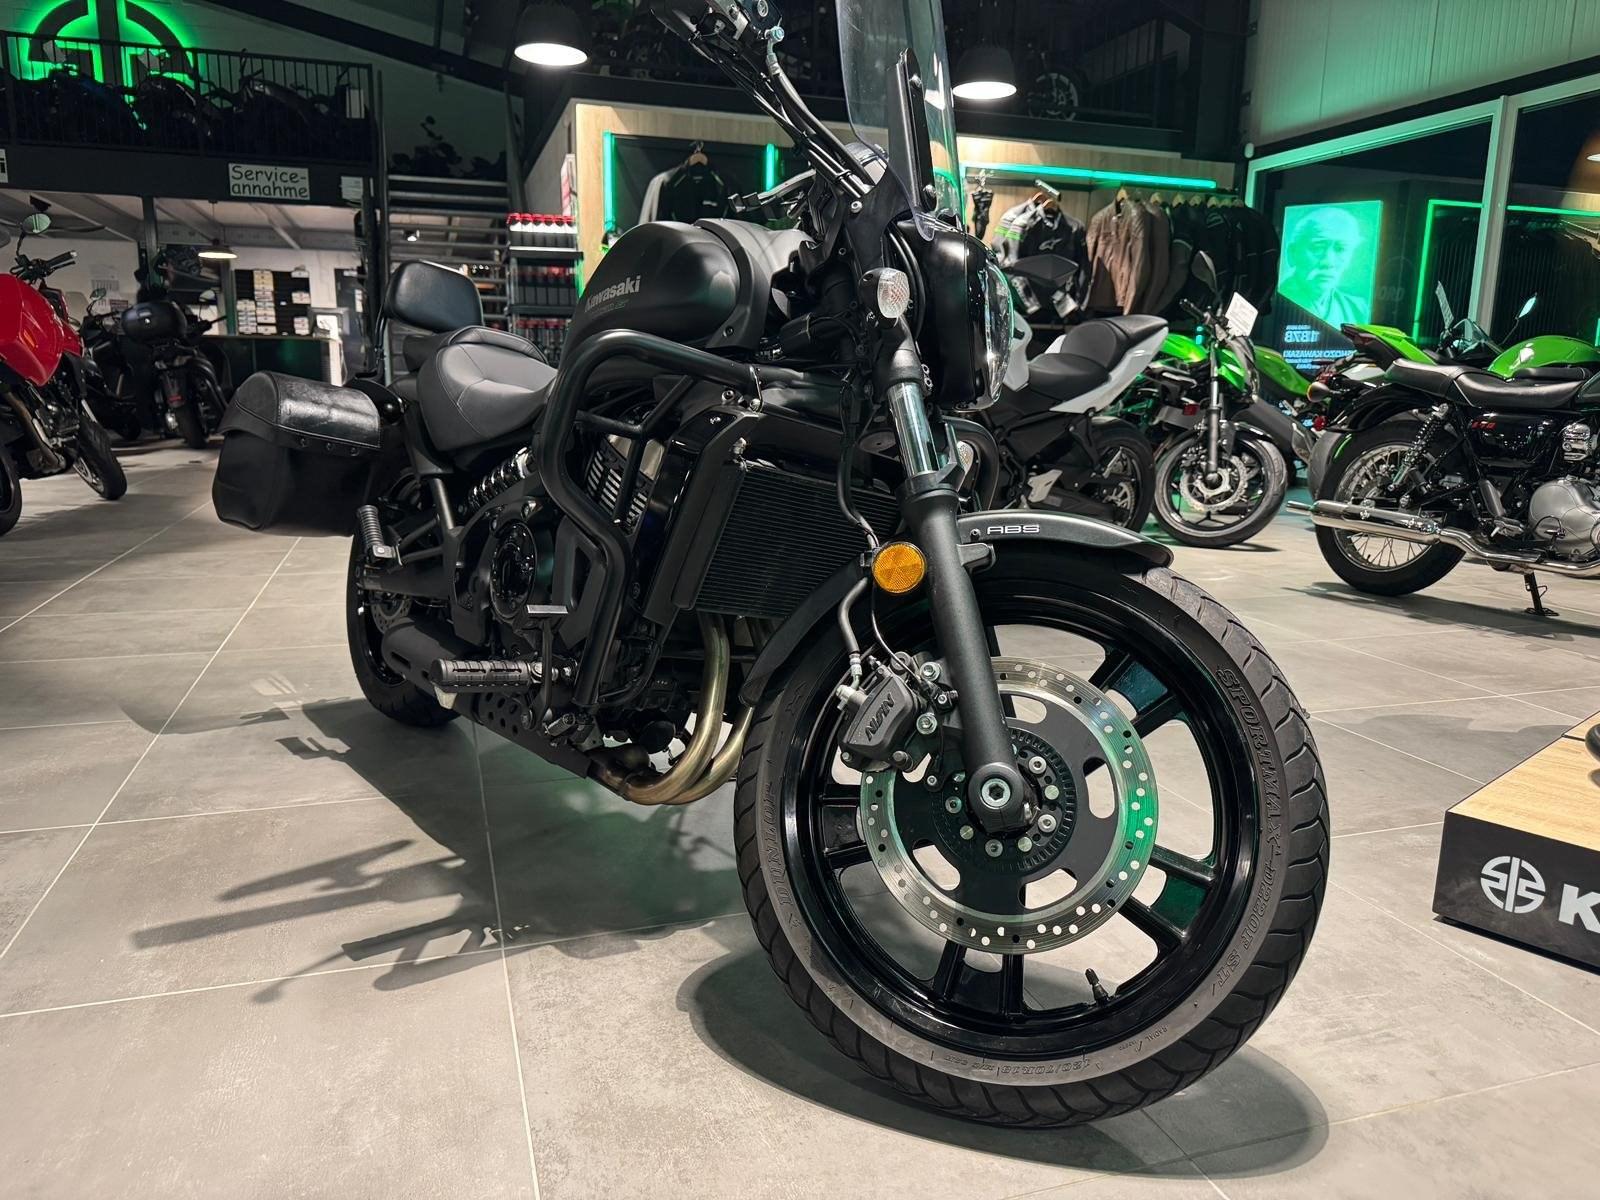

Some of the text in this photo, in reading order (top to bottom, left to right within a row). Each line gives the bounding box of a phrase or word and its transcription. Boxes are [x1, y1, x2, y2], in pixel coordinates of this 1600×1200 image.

[231, 165, 307, 184] Service-
[231, 181, 309, 199] annahme
[584, 274, 641, 313] Kawasaki
[987, 524, 1040, 535] ABS
[762, 782, 793, 906] DUNLOP
